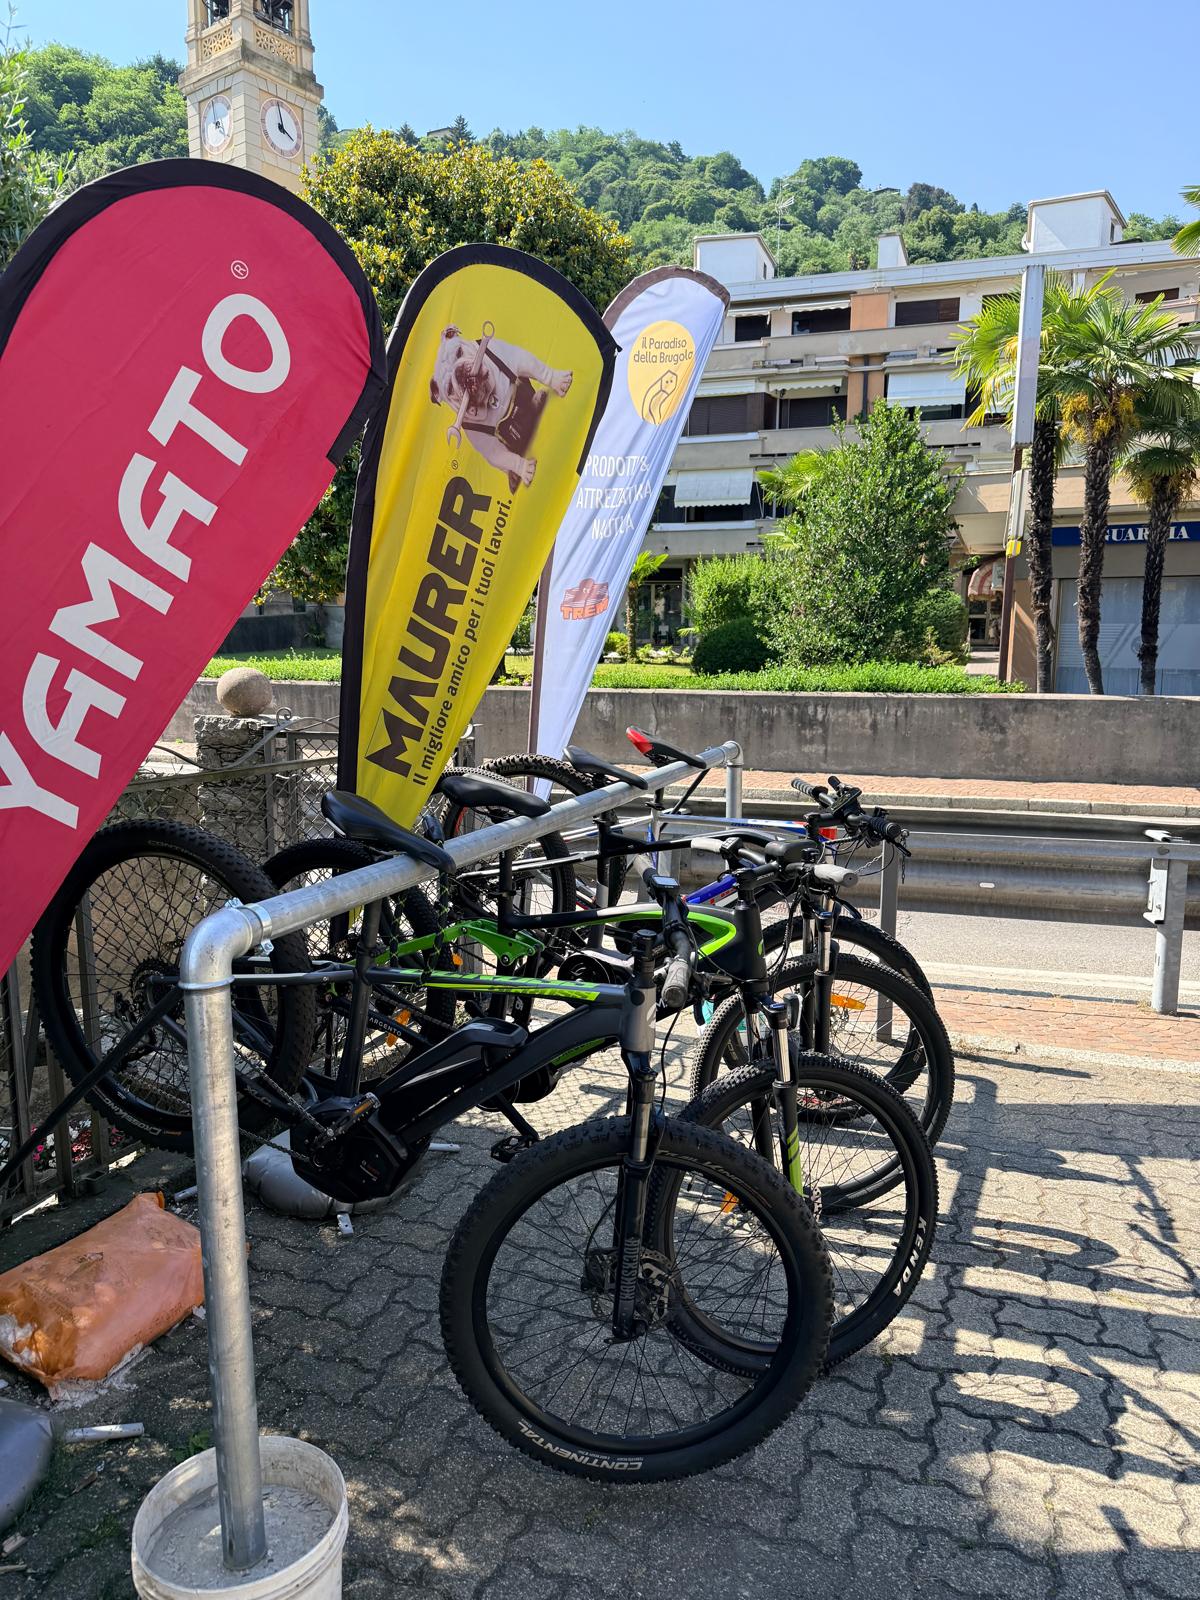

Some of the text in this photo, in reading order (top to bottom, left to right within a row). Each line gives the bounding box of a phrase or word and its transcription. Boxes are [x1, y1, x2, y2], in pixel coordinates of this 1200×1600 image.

[633, 350, 657, 363] della
[649, 337, 687, 349] Paradiso
[1103, 525, 1191, 542] UARIA
[0, 293, 291, 829] YAMATO
[365, 476, 492, 778] MAURER
[412, 499, 513, 786] Il migliore amico per i tuoi lavori.
[368, 1016, 402, 1037] ARGENTO
[892, 1215, 927, 1297] KENDA
[518, 1420, 643, 1471] CONTINENTAL
